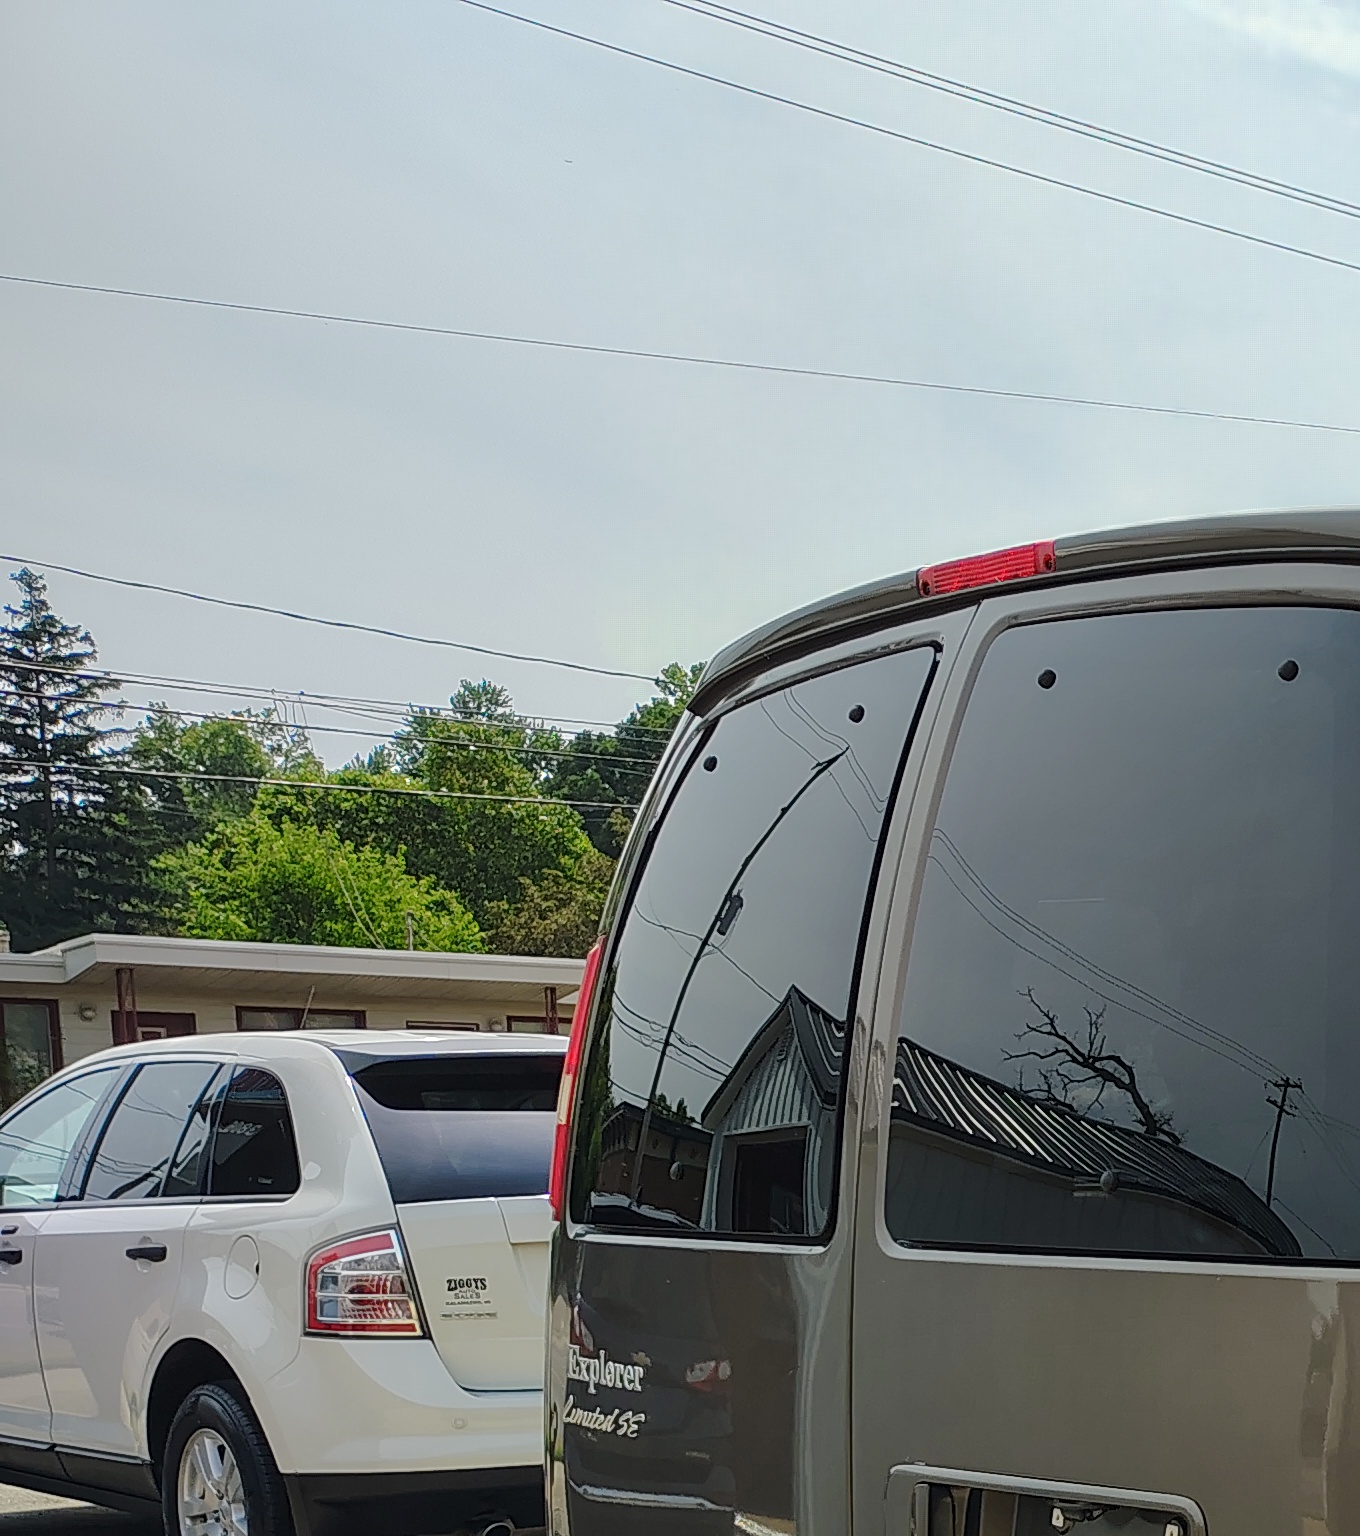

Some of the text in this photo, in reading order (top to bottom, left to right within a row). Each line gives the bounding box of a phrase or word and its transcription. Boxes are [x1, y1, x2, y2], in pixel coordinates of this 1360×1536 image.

[446, 1278, 487, 1291] ZIGGYS
[567, 1344, 643, 1394] Explorer
[563, 1394, 619, 1432] Limited
[617, 1411, 646, 1437] SE
